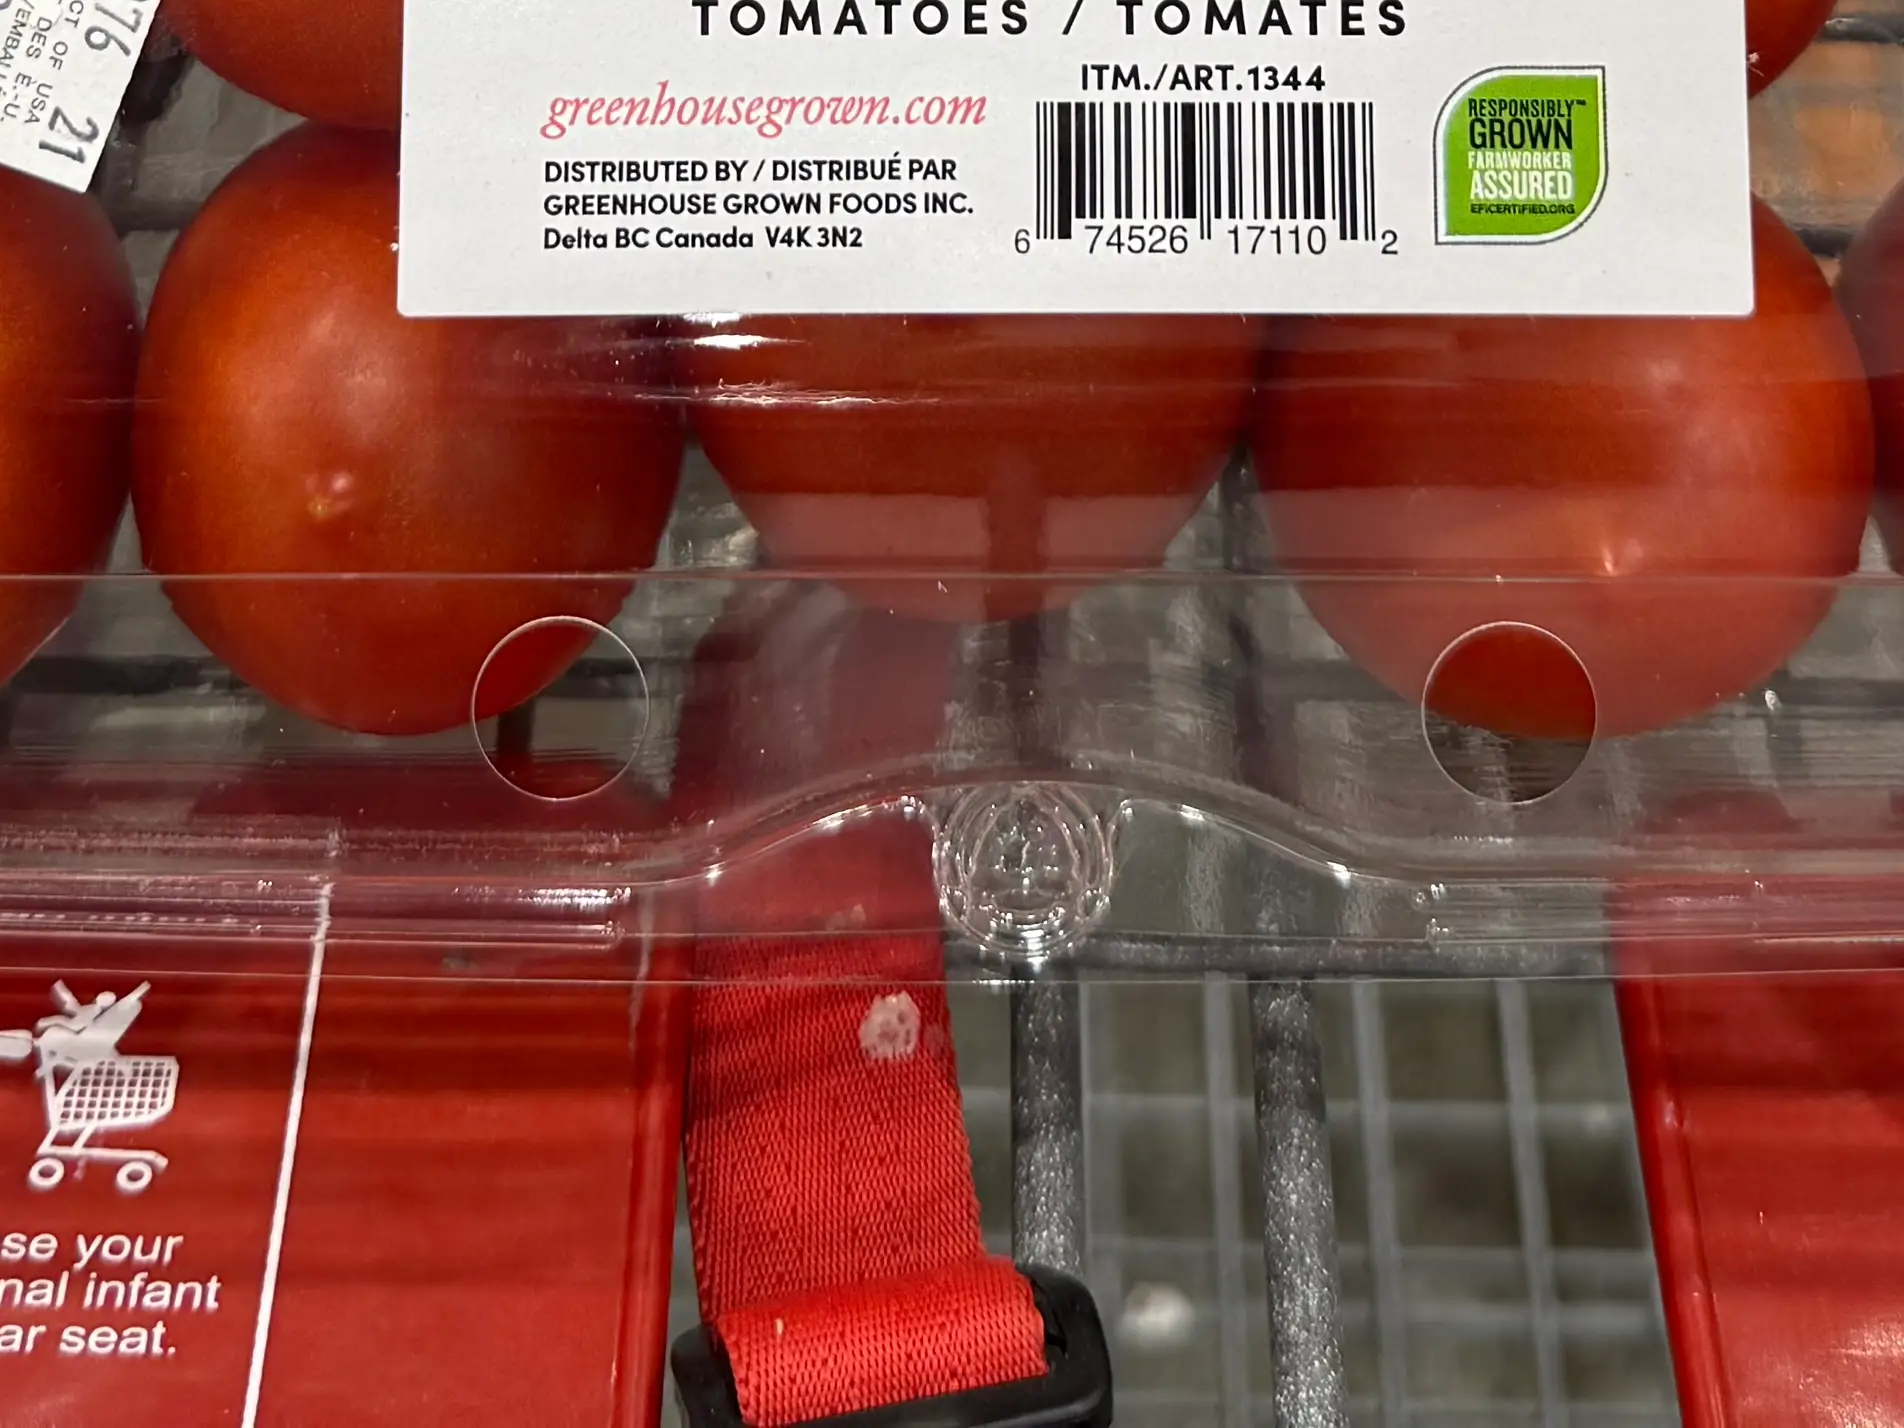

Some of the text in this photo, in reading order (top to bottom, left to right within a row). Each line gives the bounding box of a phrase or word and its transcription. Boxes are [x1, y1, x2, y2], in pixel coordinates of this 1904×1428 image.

[25, 16, 53, 60] DES
[49, 41, 69, 71] OF
[24, 83, 53, 125] USA
[540, 80, 986, 139] greenhousegrown.com
[38, 106, 100, 165] 21
[1469, 117, 1573, 150] GROWN
[545, 161, 707, 182] DISTRIBUTED
[716, 160, 748, 181] BY
[773, 152, 901, 181] DISTRIBUÉ
[909, 159, 956, 180] PAR
[1467, 150, 1573, 170] FARMWORKER
[1469, 170, 1574, 201] ASSURED
[544, 192, 973, 215] GREENHOUSE GROWN FOODS INC.
[544, 226, 862, 249] Delta BC Canada V4K 3N2
[1015, 225, 1398, 255] 6 74526 17110 2
[74, 1235, 183, 1270] your
[83, 1272, 220, 1311] infant
[60, 1321, 175, 1355] seat.
